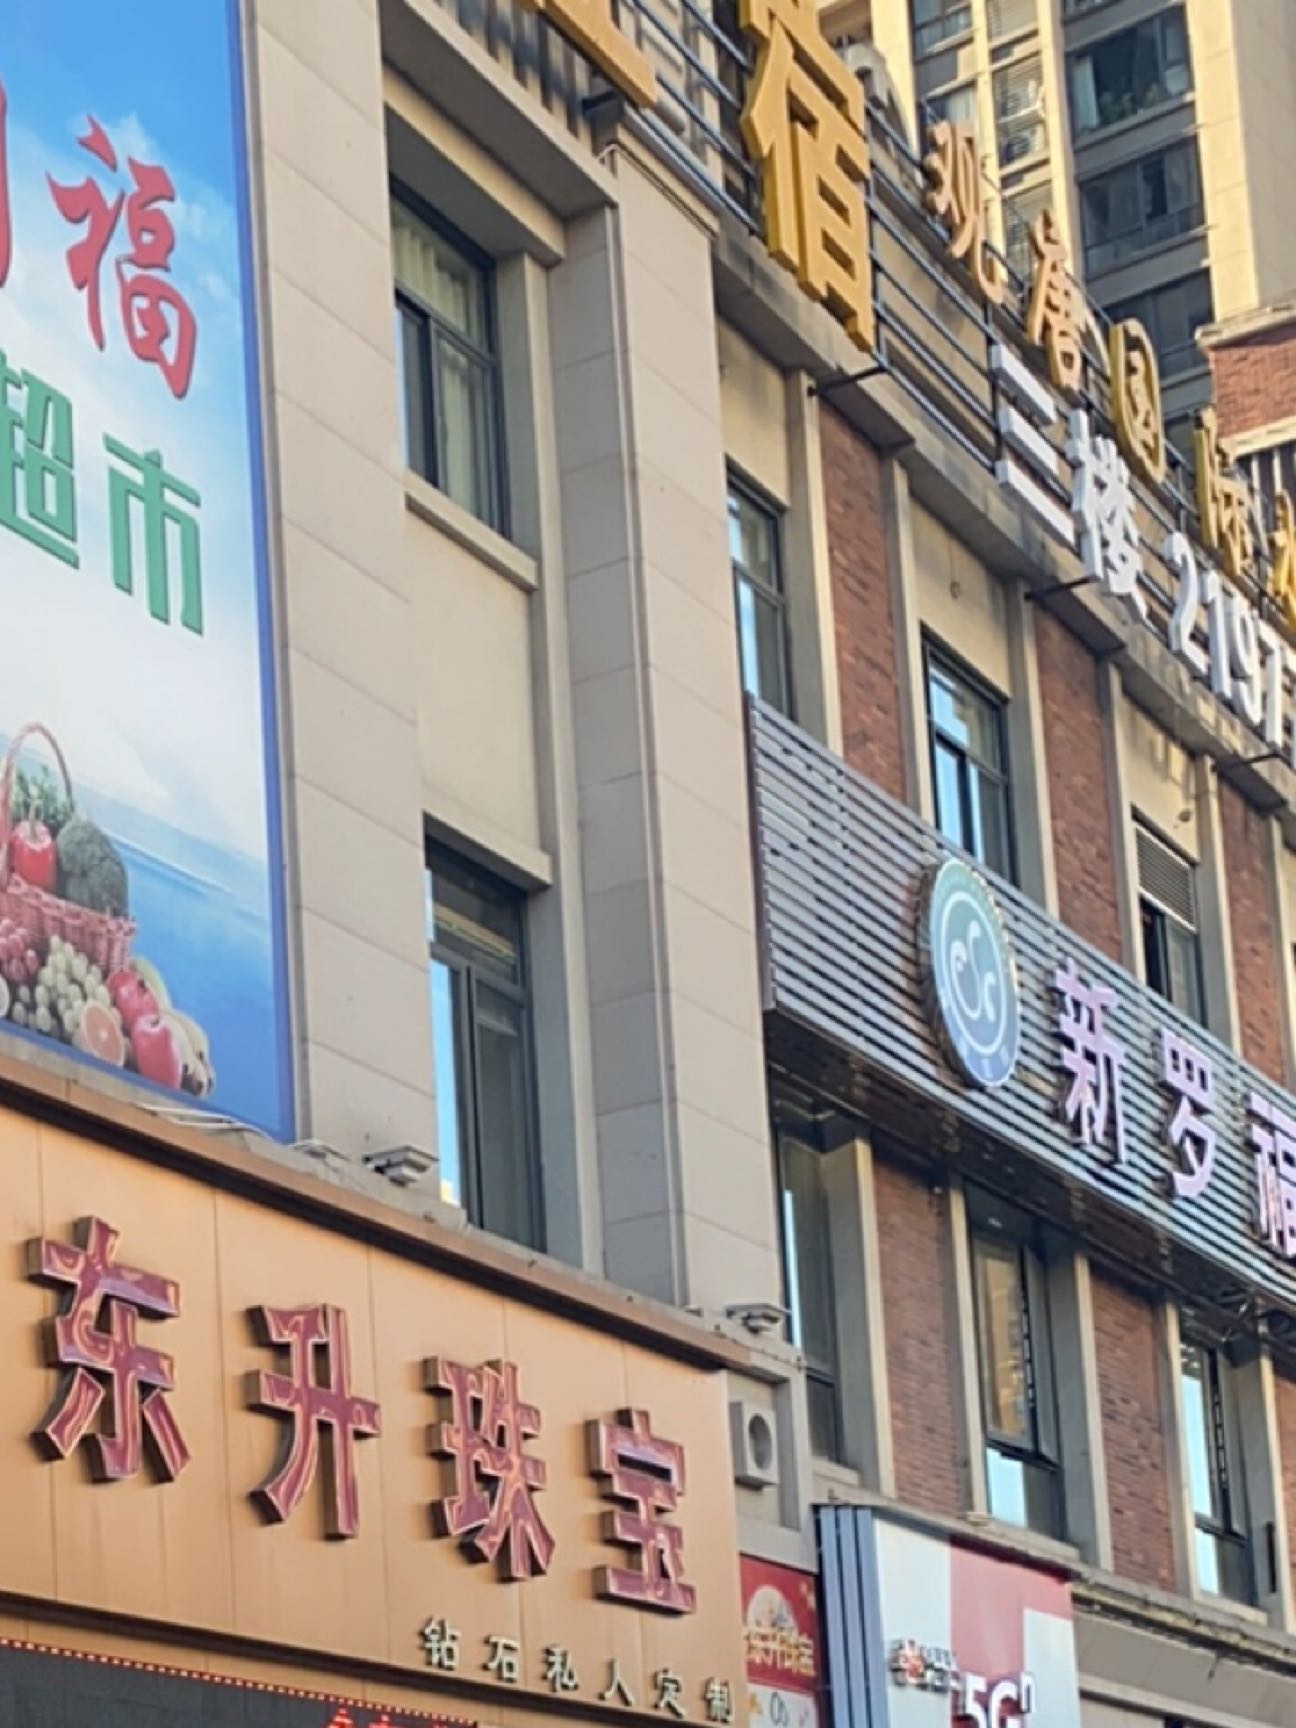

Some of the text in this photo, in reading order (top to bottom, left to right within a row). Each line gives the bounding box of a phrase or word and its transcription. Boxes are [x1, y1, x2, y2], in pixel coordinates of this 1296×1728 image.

[420, 1616, 736, 1723] 钻石私人定制
